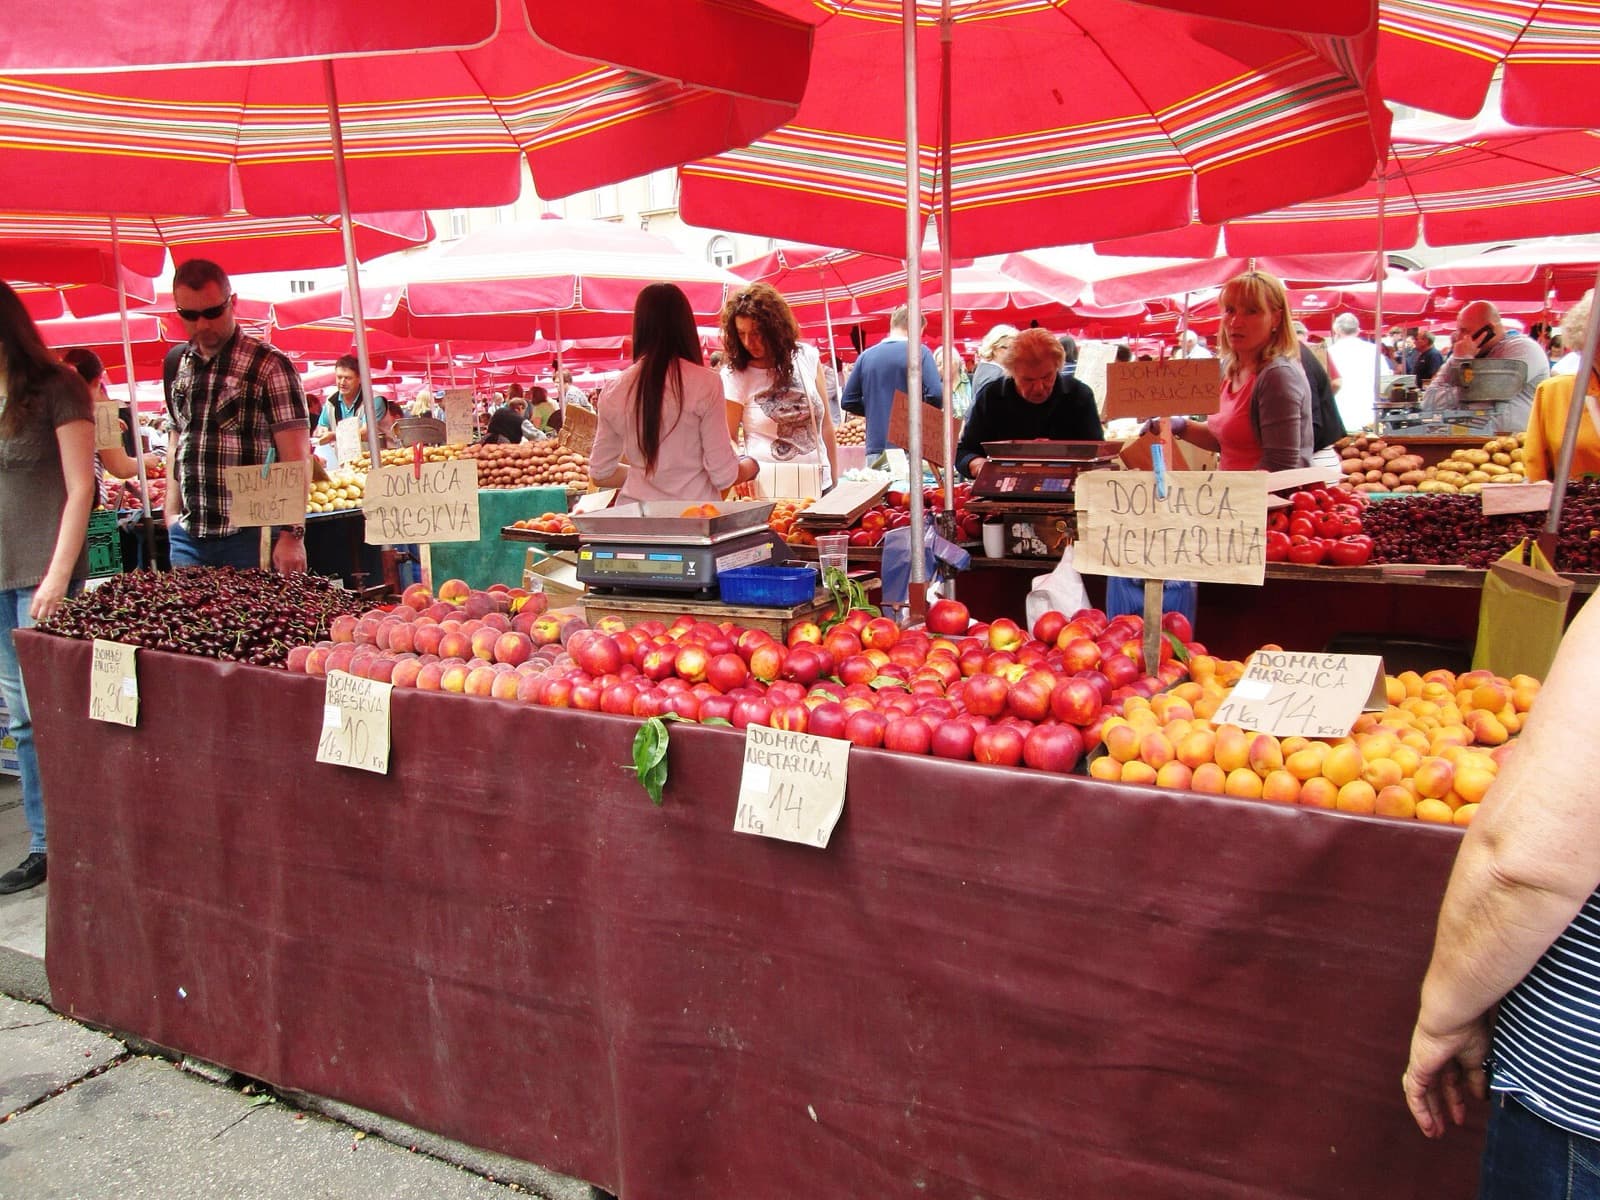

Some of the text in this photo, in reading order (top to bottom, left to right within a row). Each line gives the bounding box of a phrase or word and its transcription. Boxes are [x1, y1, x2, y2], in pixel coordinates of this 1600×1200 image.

[381, 463, 462, 497] DOMAĆA
[1106, 473, 1238, 520] DOMAĆA
[376, 501, 473, 538] BRESKVA
[1102, 520, 1263, 567] NEKTARINA
[1248, 666, 1349, 689] MARELICA
[1268, 692, 1318, 734] 14
[342, 716, 369, 765] 10
[769, 782, 803, 830] 14
